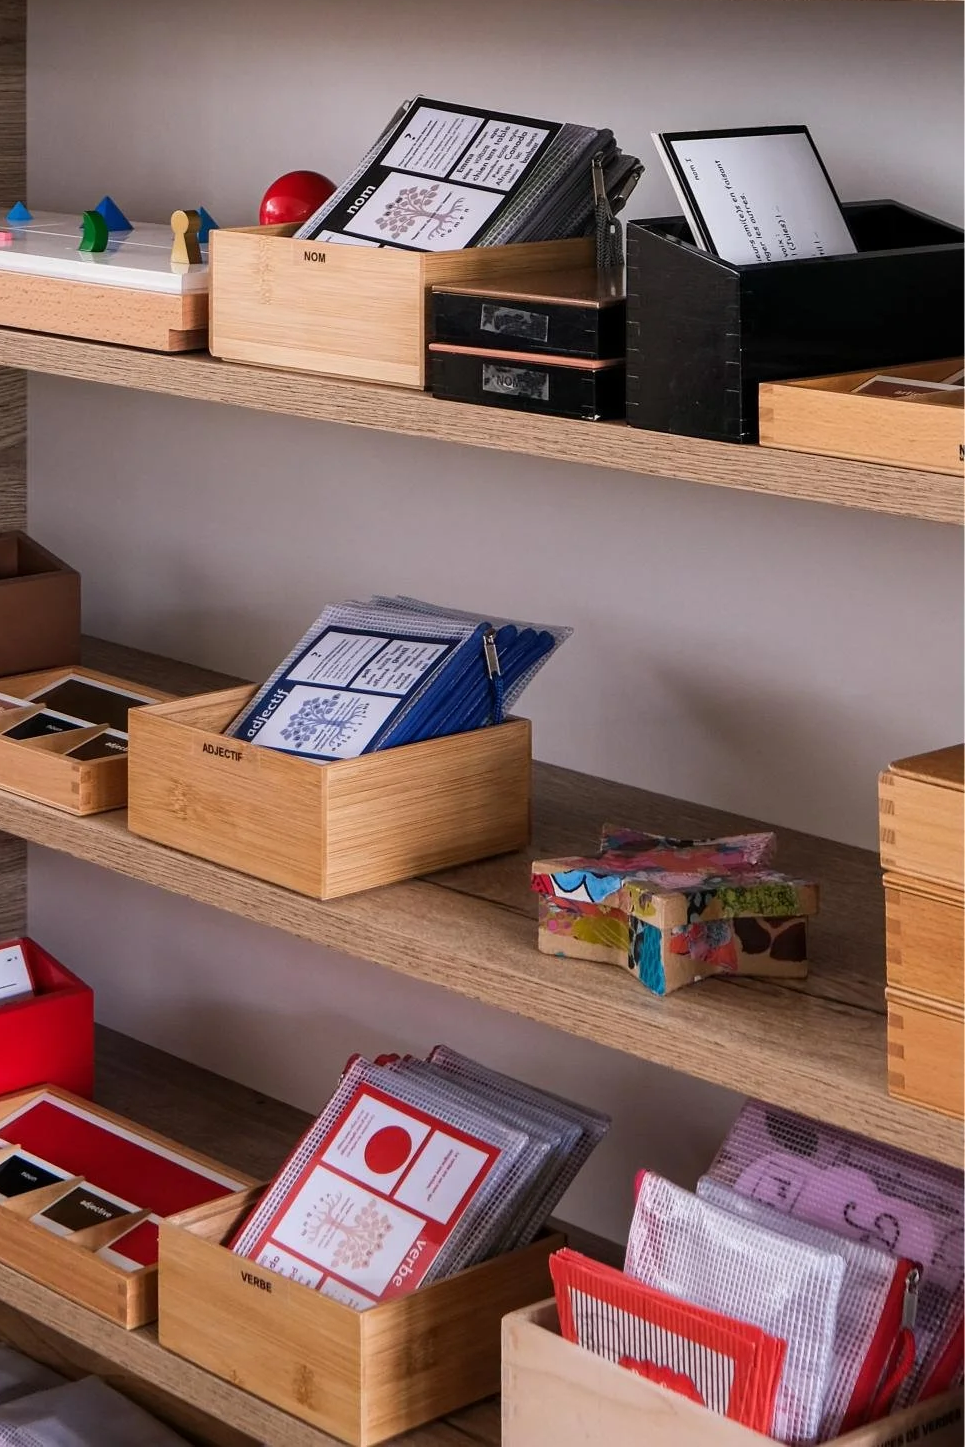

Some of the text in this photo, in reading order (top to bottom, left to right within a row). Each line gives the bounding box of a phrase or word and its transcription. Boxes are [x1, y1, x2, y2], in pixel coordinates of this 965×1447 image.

[470, 161, 488, 181] chien
[492, 125, 511, 145] table
[503, 130, 528, 159] Canada
[519, 142, 539, 163] bonheur
[456, 153, 474, 173] Emma
[494, 162, 515, 185] Afrique
[690, 165, 700, 180] nom
[714, 159, 732, 189] faisant
[346, 184, 377, 217] nom
[730, 192, 738, 202] en
[740, 192, 755, 223] autres.
[754, 226, 763, 239] les
[304, 251, 325, 263] NOM
[247, 688, 291, 738] adjectif
[202, 743, 243, 762] ADJECTIF
[79, 1199, 112, 1219] adjective
[392, 1237, 428, 1287] verbe
[240, 1270, 272, 1294] VERBE
